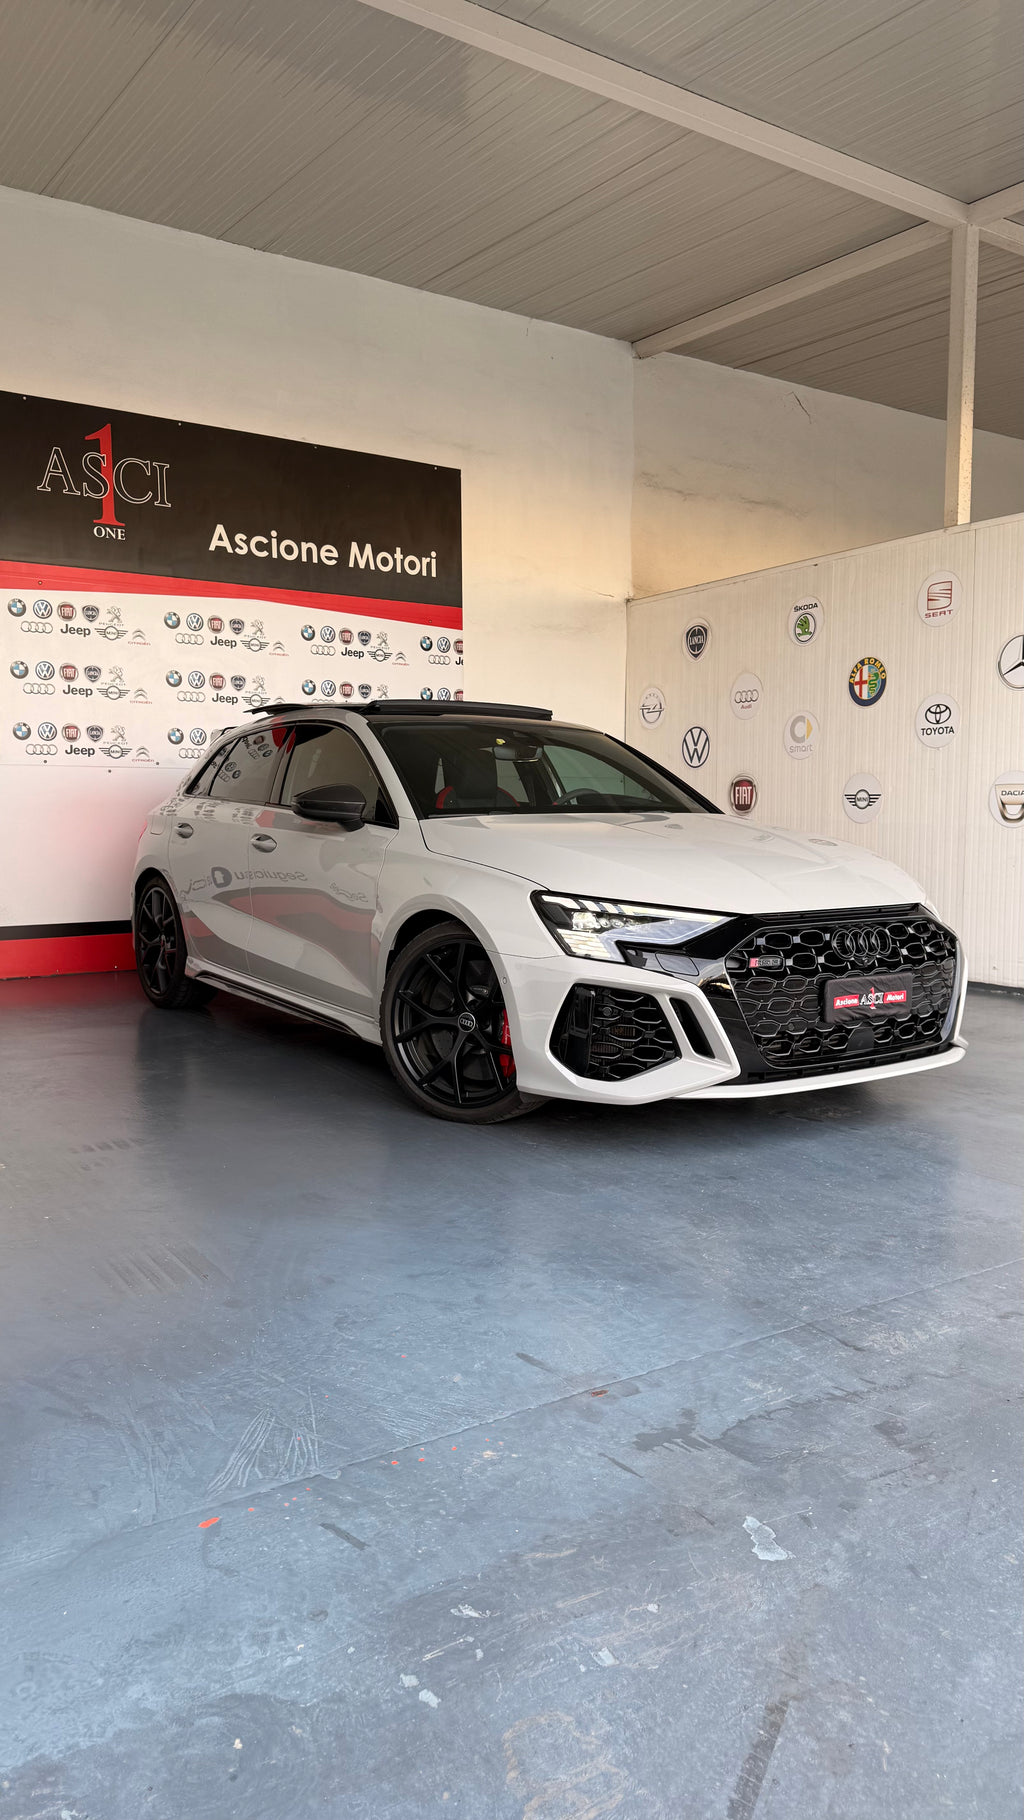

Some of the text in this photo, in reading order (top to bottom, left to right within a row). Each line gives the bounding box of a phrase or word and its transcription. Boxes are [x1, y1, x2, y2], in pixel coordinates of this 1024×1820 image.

[37, 446, 171, 507] ASCI
[93, 525, 126, 540] ONE
[208, 524, 437, 578] Ascione Motori
[925, 609, 953, 618] SEAT
[60, 623, 91, 637] Jeep
[210, 635, 237, 649] Jeep
[341, 647, 365, 659] Jeep
[864, 658, 886, 679] ROMEO
[62, 684, 93, 698] Jeep
[211, 692, 239, 705] Jeep
[921, 726, 955, 736] TOYOTA
[65, 744, 96, 757] Jeep
[789, 744, 813, 753] smart
[735, 786, 752, 805] FIAT
[886, 993, 904, 1001] Motori
